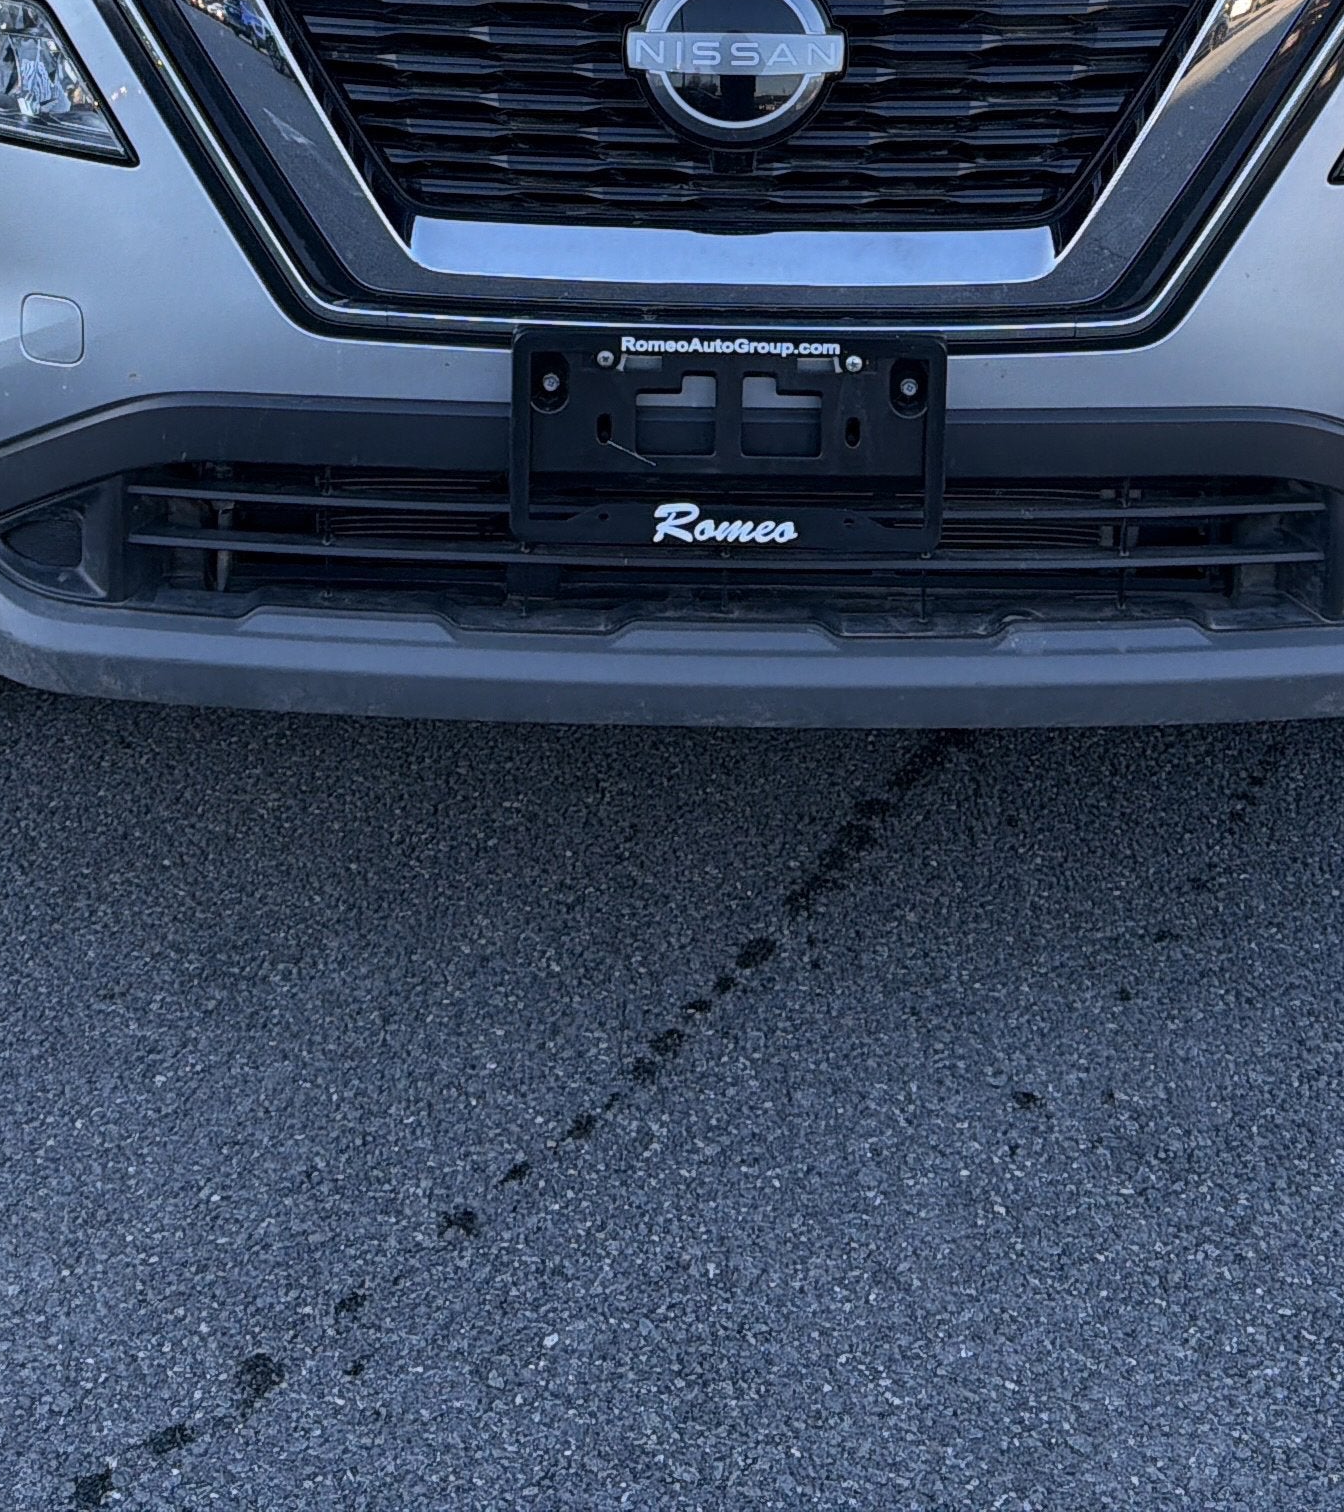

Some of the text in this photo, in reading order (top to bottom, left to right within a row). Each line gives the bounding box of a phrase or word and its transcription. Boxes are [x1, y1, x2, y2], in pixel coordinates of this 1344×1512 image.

[635, 39, 837, 66] NISSAN
[620, 336, 841, 357] RomeoAutoGroup.com
[652, 502, 799, 544] Romeo
